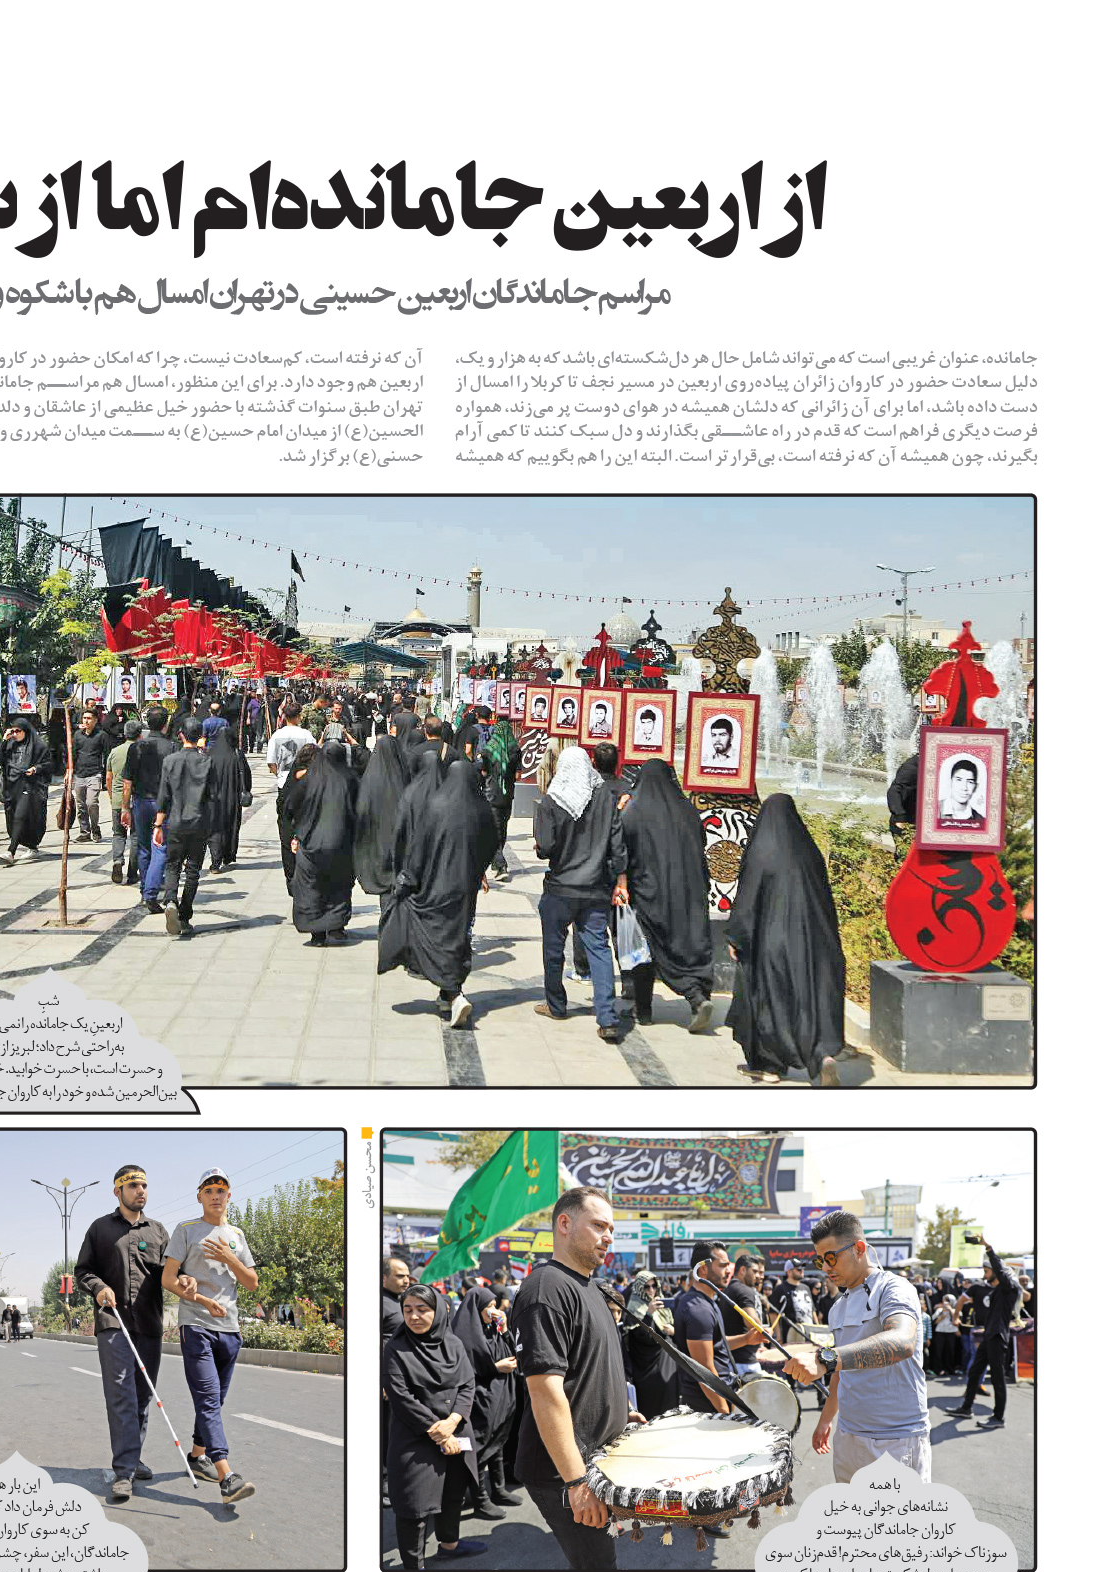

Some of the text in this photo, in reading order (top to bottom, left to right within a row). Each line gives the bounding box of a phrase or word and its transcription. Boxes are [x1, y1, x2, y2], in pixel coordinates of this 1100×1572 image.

[92, 160, 184, 236] اما
[15, 160, 82, 258] از
[554, 160, 763, 258] اربعین
[760, 160, 827, 258] از
[95, 284, 136, 315] هم
[138, 278, 209, 314] امسال
[300, 285, 396, 315] حسینی
[398, 278, 472, 315] اربعین
[473, 278, 598, 311] جاماندگان
[599, 278, 671, 315] مراسم
[30, 354, 46, 368] در
[49, 352, 90, 368] حضور
[94, 351, 133, 368] امکان
[137, 351, 153, 363] که
[157, 351, 180, 368] چرا
[346, 350, 381, 368] نرفته
[385, 351, 401, 363] که
[405, 348, 423, 368] آن
[487, 357, 494, 368] و
[497, 351, 525, 368] هزار
[529, 354, 541, 367] به
[544, 351, 560, 363] که
[563, 351, 595, 367] باشد
[692, 354, 708, 368] هر
[712, 351, 739, 368] حال
[743, 351, 779, 368] شامل
[839, 351, 855, 363] که
[858, 351, 889, 363] است
[893, 351, 936, 369] غریبی
[939, 351, 979, 368] عنوان
[309, 448, 349, 466] برگزار
[362, 1142, 375, 1208] محسن صیادی
[9, 1478, 20, 1494] بار
[23, 1478, 40, 1494] این
[824, 1501, 848, 1516] خیل
[852, 1504, 861, 1515] به
[864, 1500, 895, 1516] جوانی
